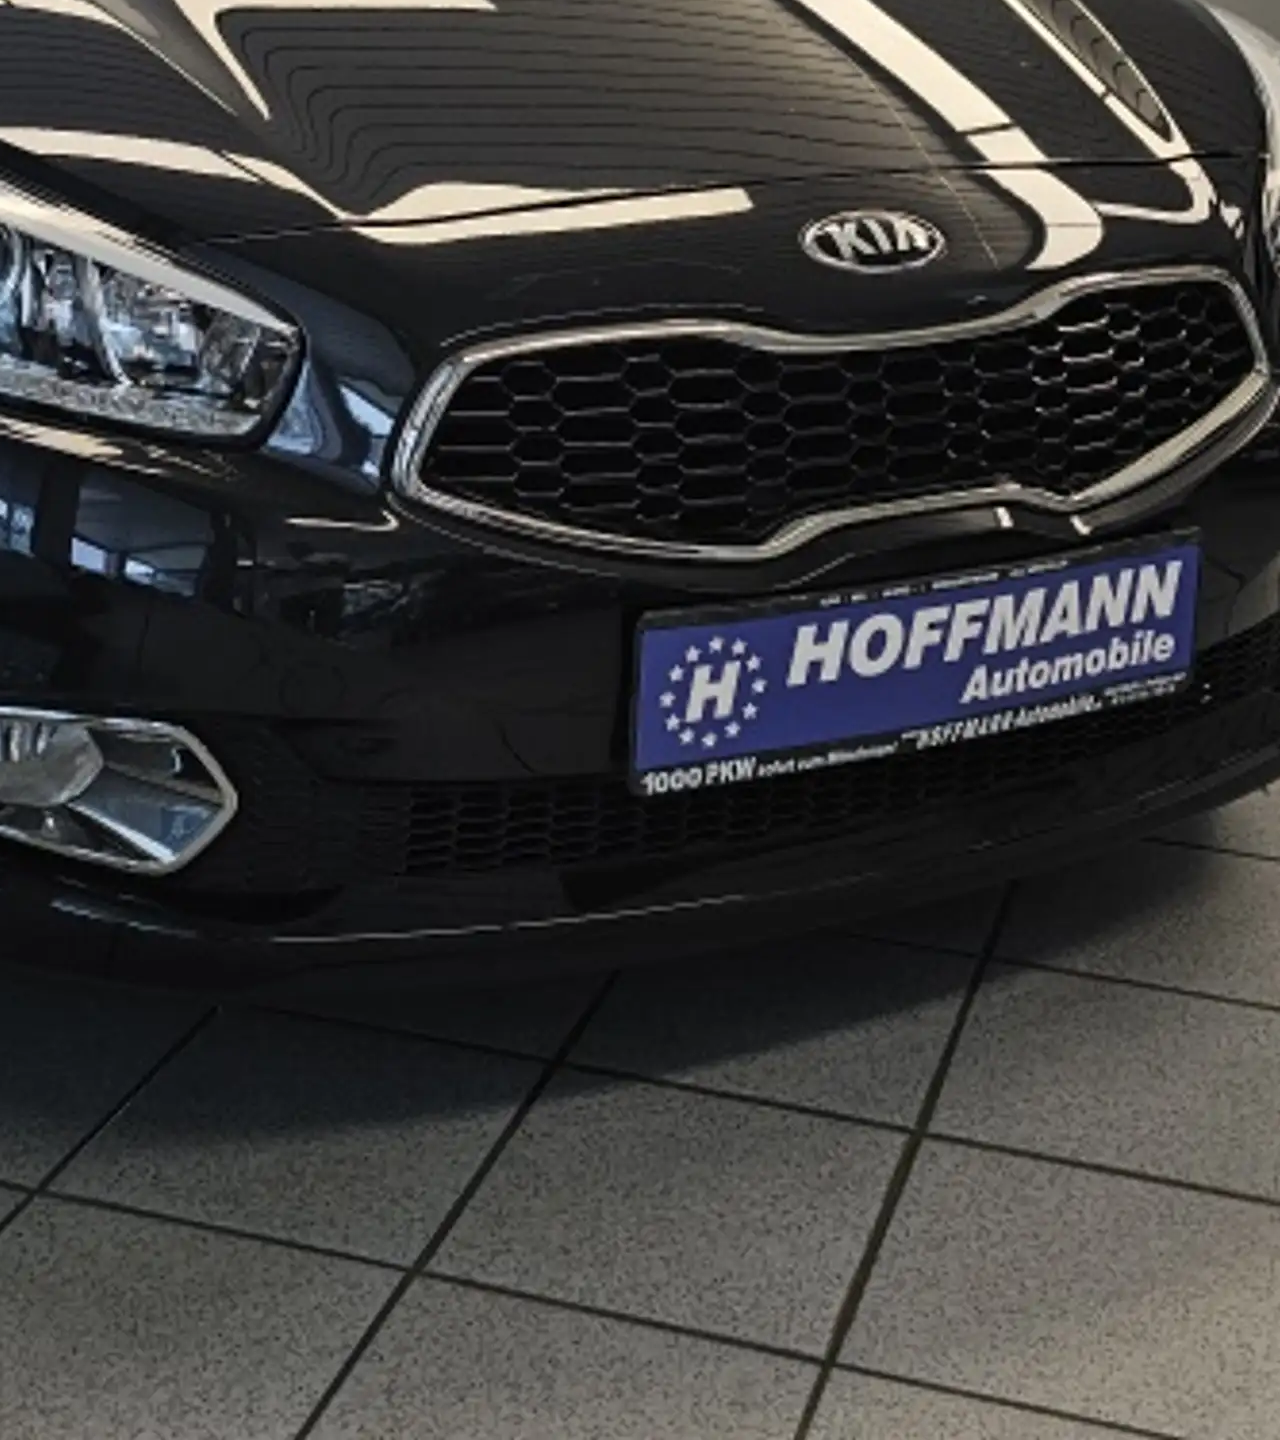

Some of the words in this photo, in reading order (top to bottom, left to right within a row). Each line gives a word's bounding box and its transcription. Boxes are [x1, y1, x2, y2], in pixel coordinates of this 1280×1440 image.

[824, 218, 929, 261] KIA
[785, 560, 1183, 688] HOFFMANN
[685, 660, 741, 723] H
[958, 629, 1175, 704] Automobile
[640, 768, 703, 796] 1000
[705, 756, 757, 786] PKW
